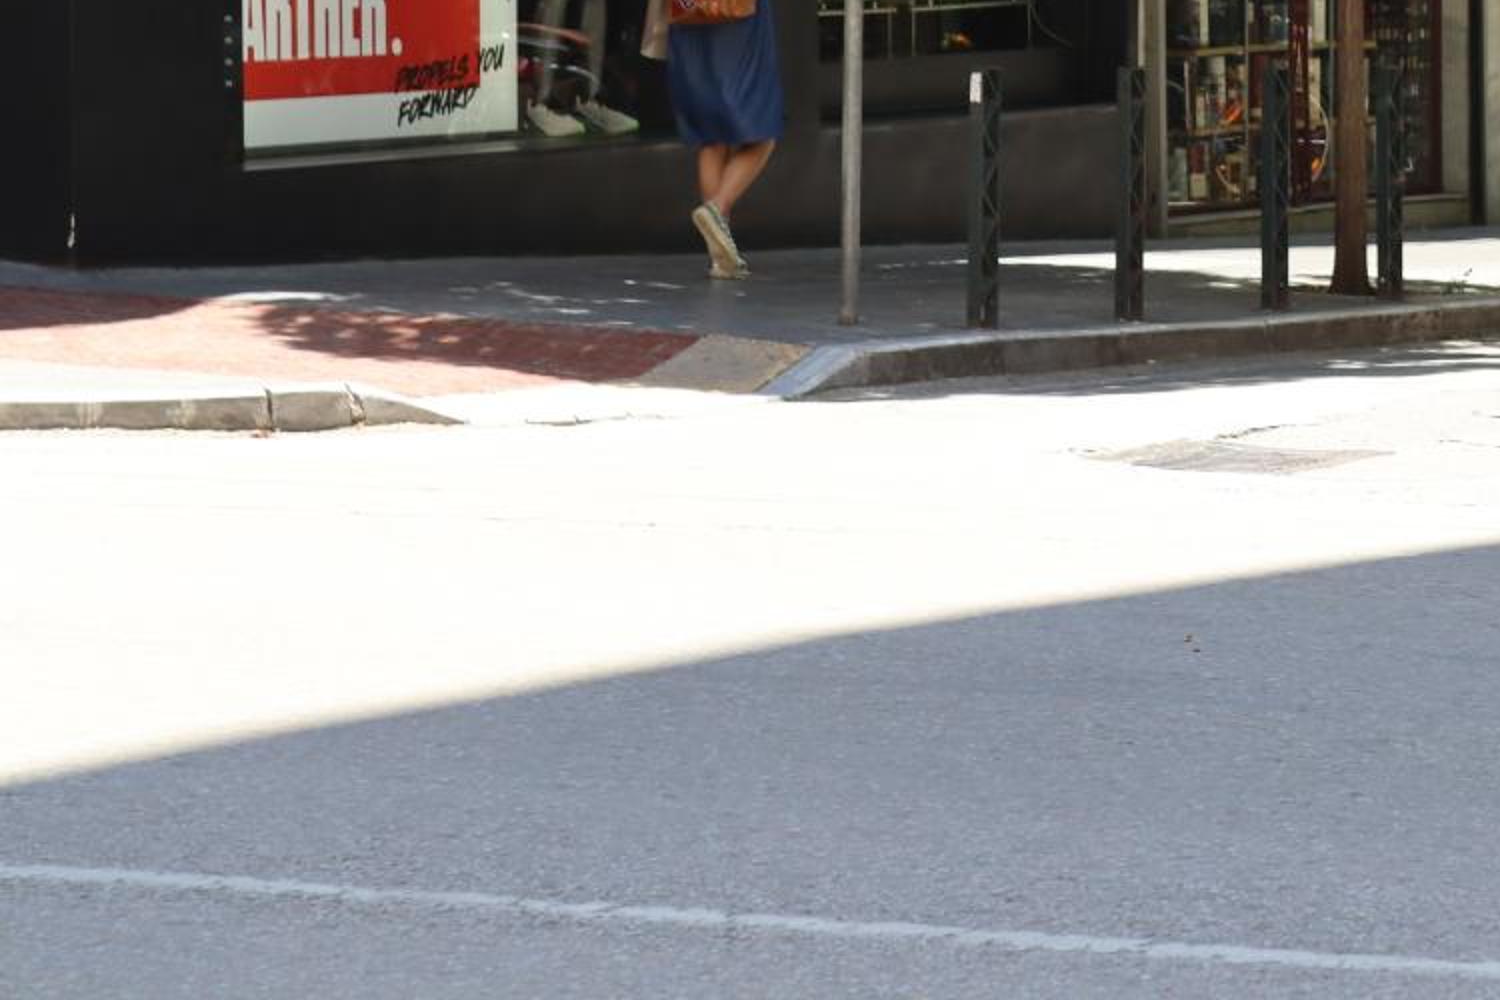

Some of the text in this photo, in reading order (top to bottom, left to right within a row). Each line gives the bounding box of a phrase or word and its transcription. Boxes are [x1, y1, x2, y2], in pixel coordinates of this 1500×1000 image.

[395, 44, 505, 92] PROPELS YOU
[397, 85, 479, 127] FORWARD
